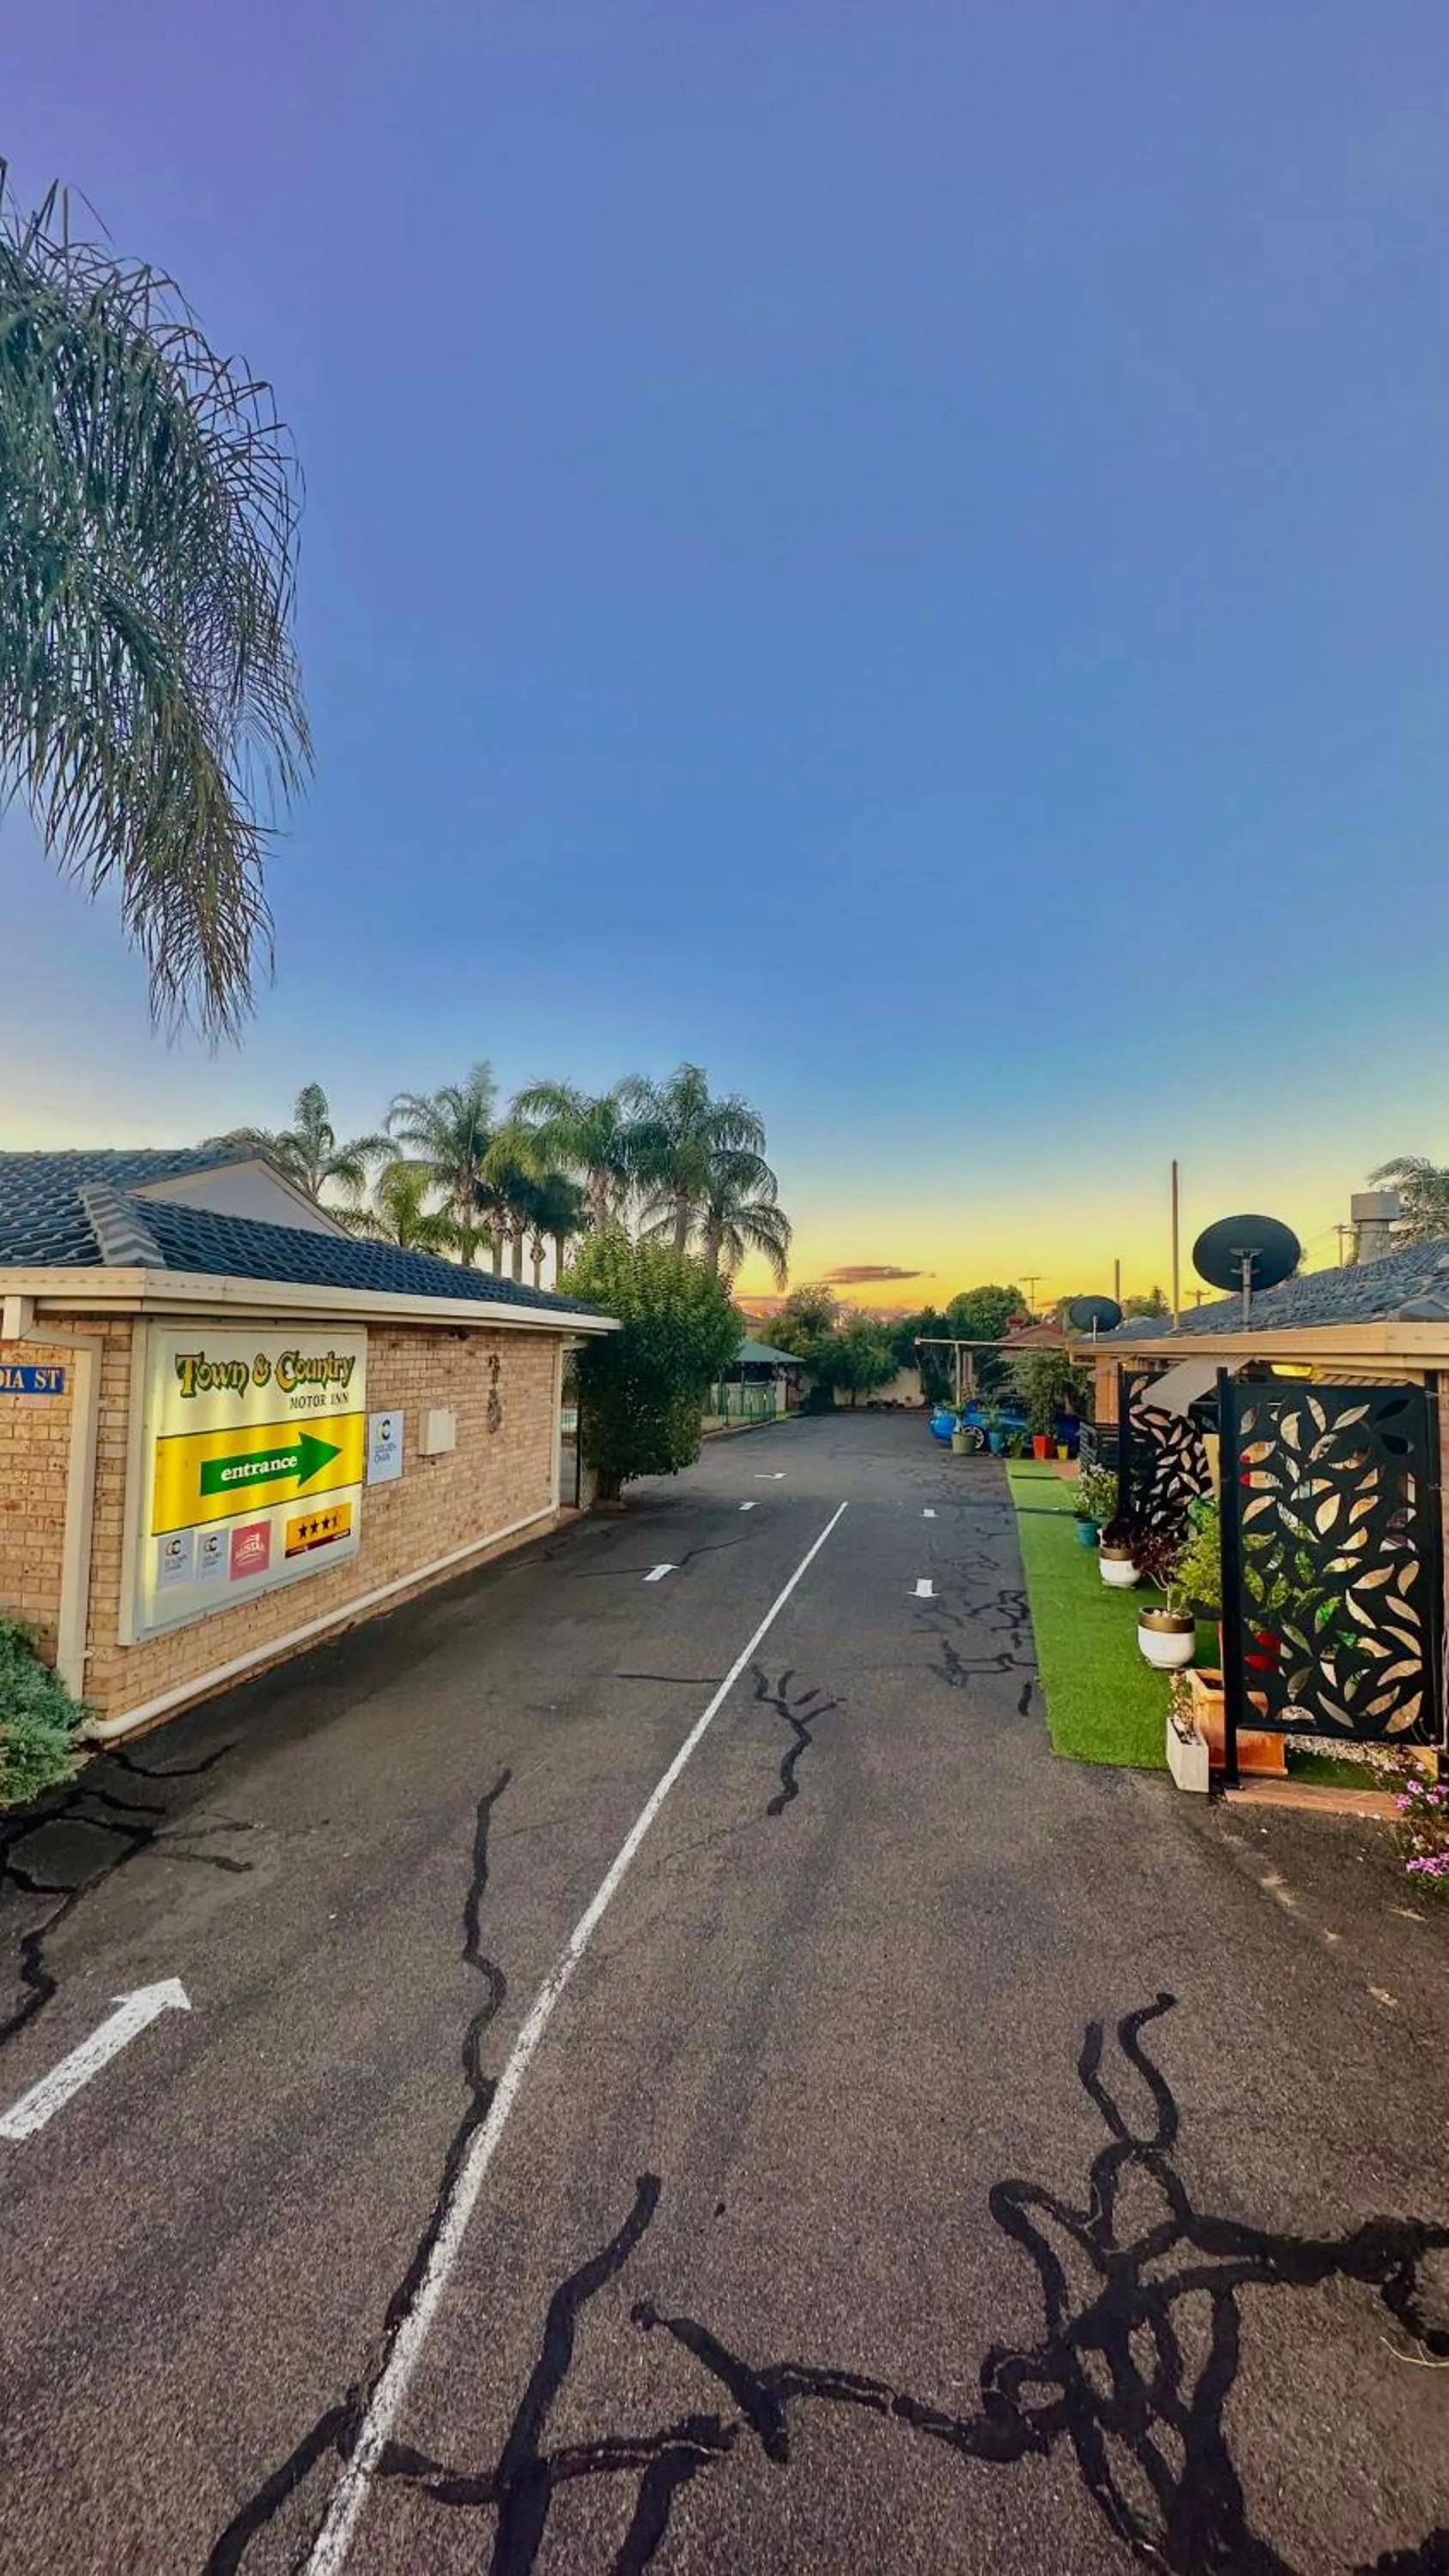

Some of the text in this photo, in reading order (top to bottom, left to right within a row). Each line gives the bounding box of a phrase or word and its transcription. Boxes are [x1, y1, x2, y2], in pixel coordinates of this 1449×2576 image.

[35, 1369, 59, 1388] ST
[175, 1350, 355, 1398] Town & Country
[289, 1392, 349, 1409] MOTOR INN
[221, 1455, 298, 1480] entrance
